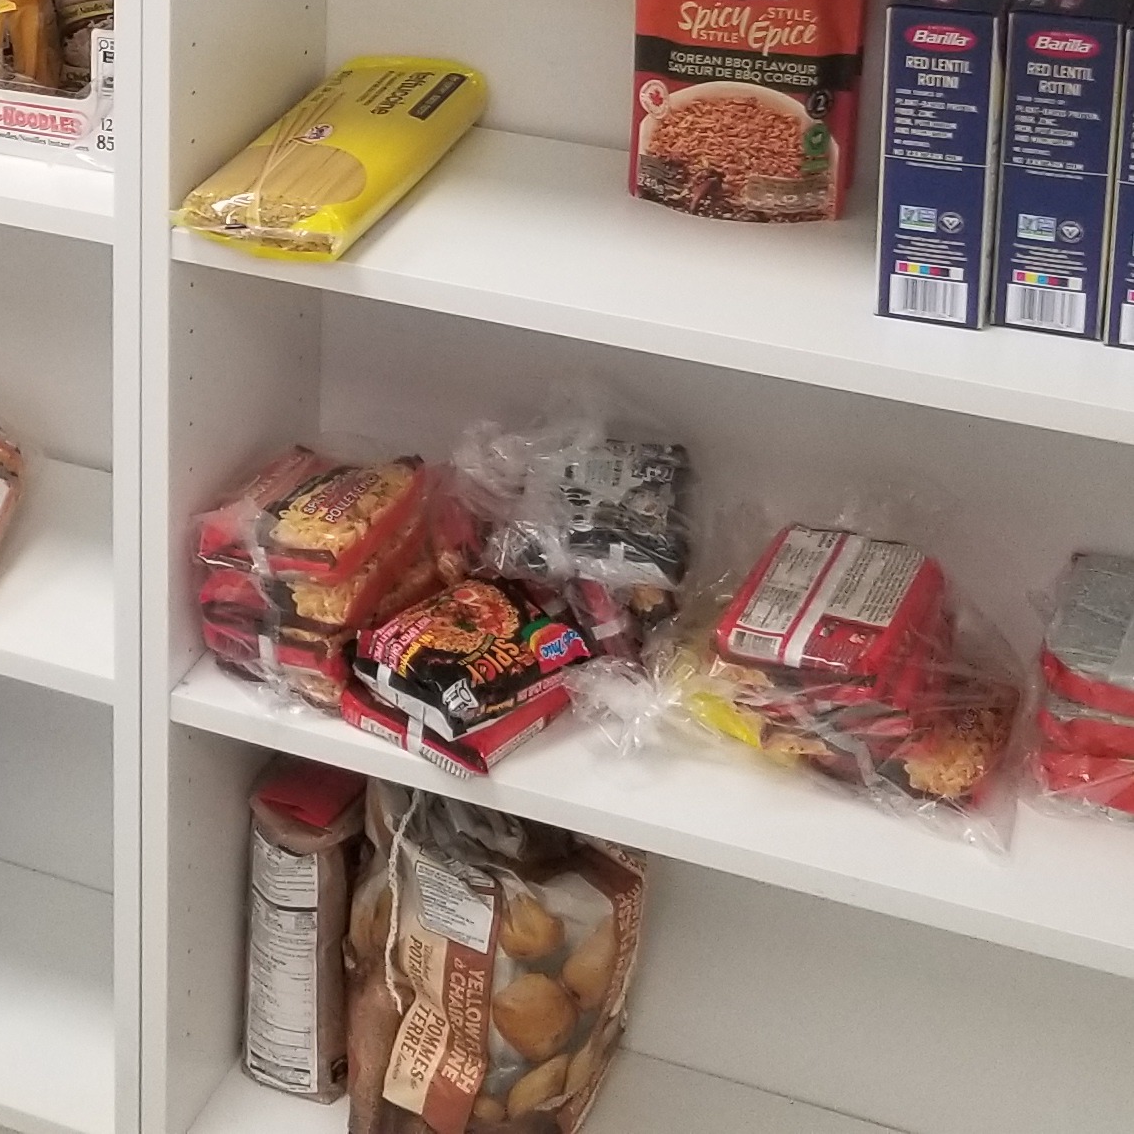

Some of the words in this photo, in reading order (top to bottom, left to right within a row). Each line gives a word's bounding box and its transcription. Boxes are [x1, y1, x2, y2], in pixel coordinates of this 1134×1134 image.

[677, 0, 751, 41] Spicy
[767, 7, 811, 22] STYLE
[699, 31, 739, 44] STYLE
[913, 29, 971, 46] Barilla
[1034, 35, 1093, 53] Barilla
[667, 61, 713, 76] SAVEUR
[715, 65, 733, 78] DE
[734, 67, 762, 81] BBQ
[670, 51, 722, 67] KOREAN
[725, 55, 752, 70] BBQ
[754, 59, 817, 75] FLAVOUR
[931, 57, 973, 74] LENTIL
[2, 105, 83, 135] NOODLES
[465, 637, 520, 689] SPICY
[464, 969, 485, 1040] YELLOW
[400, 1003, 433, 1061] TERRE
[410, 1012, 447, 1082] POMMES
